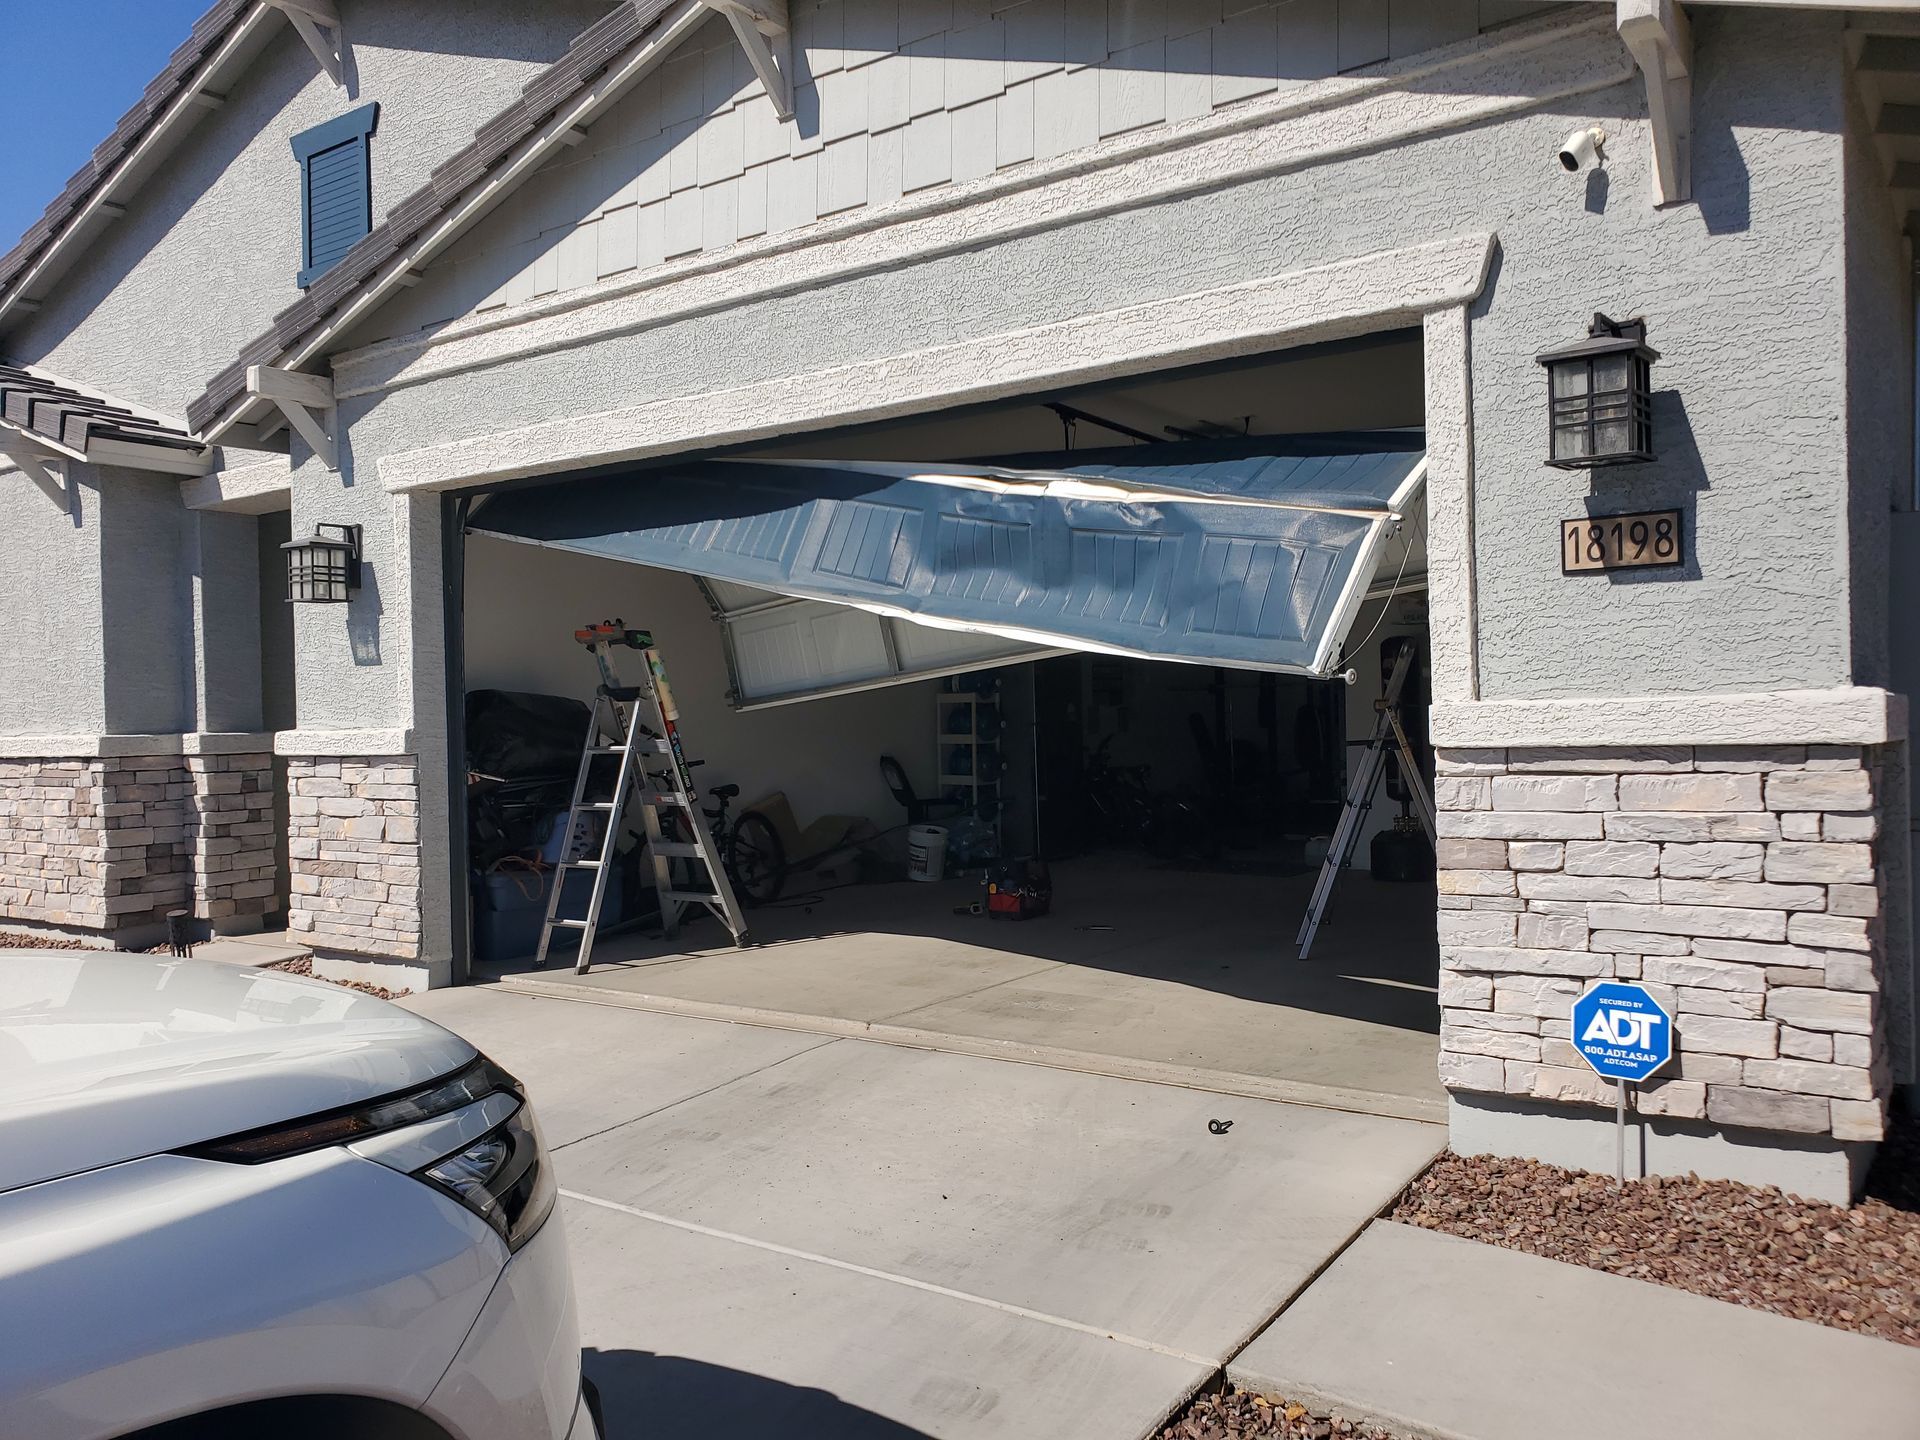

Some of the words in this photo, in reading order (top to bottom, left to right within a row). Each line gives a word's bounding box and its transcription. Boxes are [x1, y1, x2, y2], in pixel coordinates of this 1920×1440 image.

[1568, 519, 1674, 564] 18198
[1599, 998, 1632, 1007] SECURED
[1581, 1009, 1661, 1049] ADT
[1584, 1045, 1657, 1062] 800.ADT.ASAP
[1603, 1058, 1638, 1068] ADT.COM
